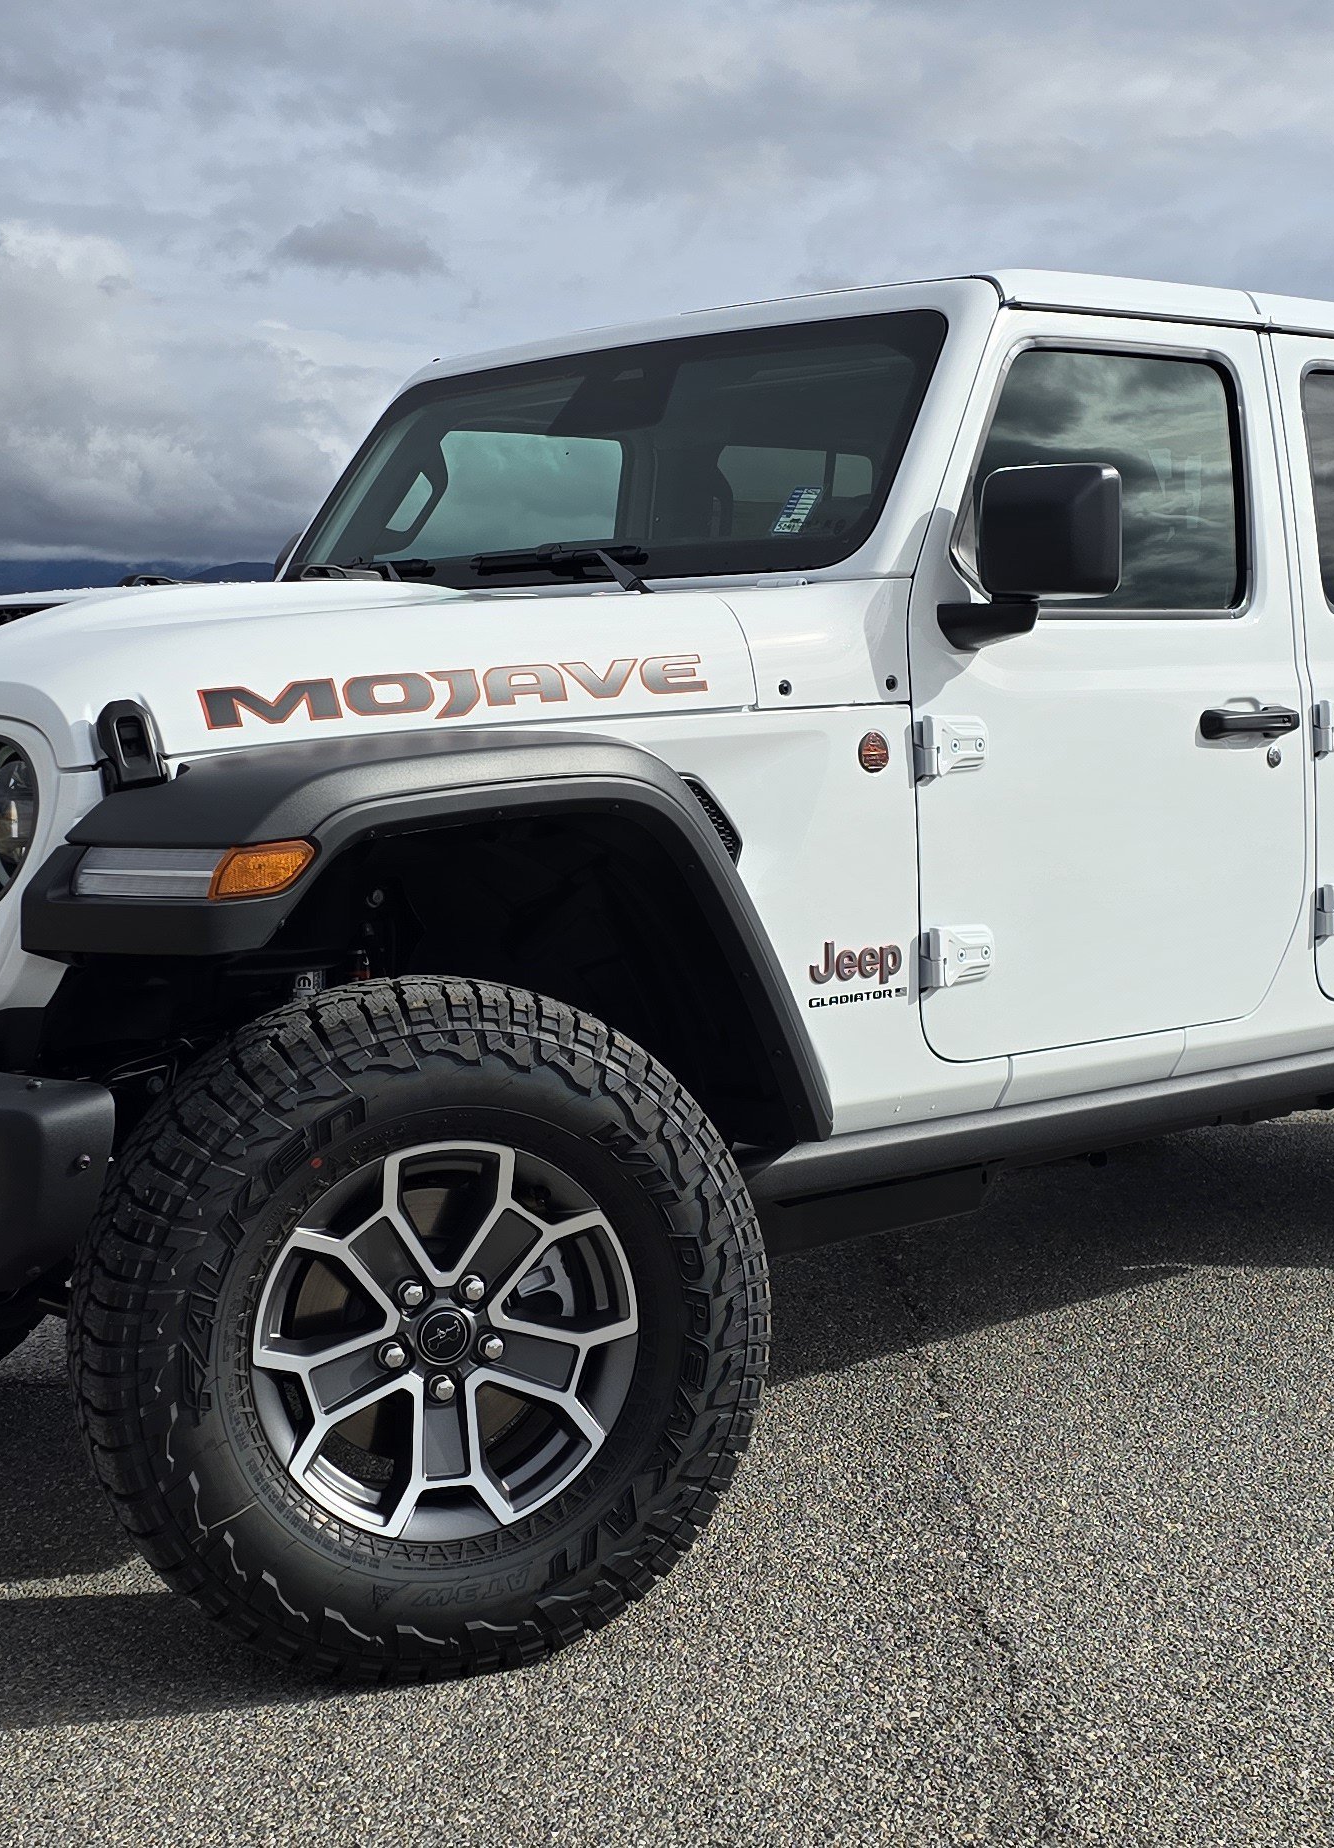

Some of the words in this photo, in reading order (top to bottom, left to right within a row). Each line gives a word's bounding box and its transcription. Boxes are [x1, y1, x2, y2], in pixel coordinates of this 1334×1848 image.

[196, 654, 709, 731] MOJAVE
[809, 940, 902, 985] Jeep
[808, 988, 893, 1009] GLADIATOR
[586, 1120, 711, 1497] WILDPEAK
